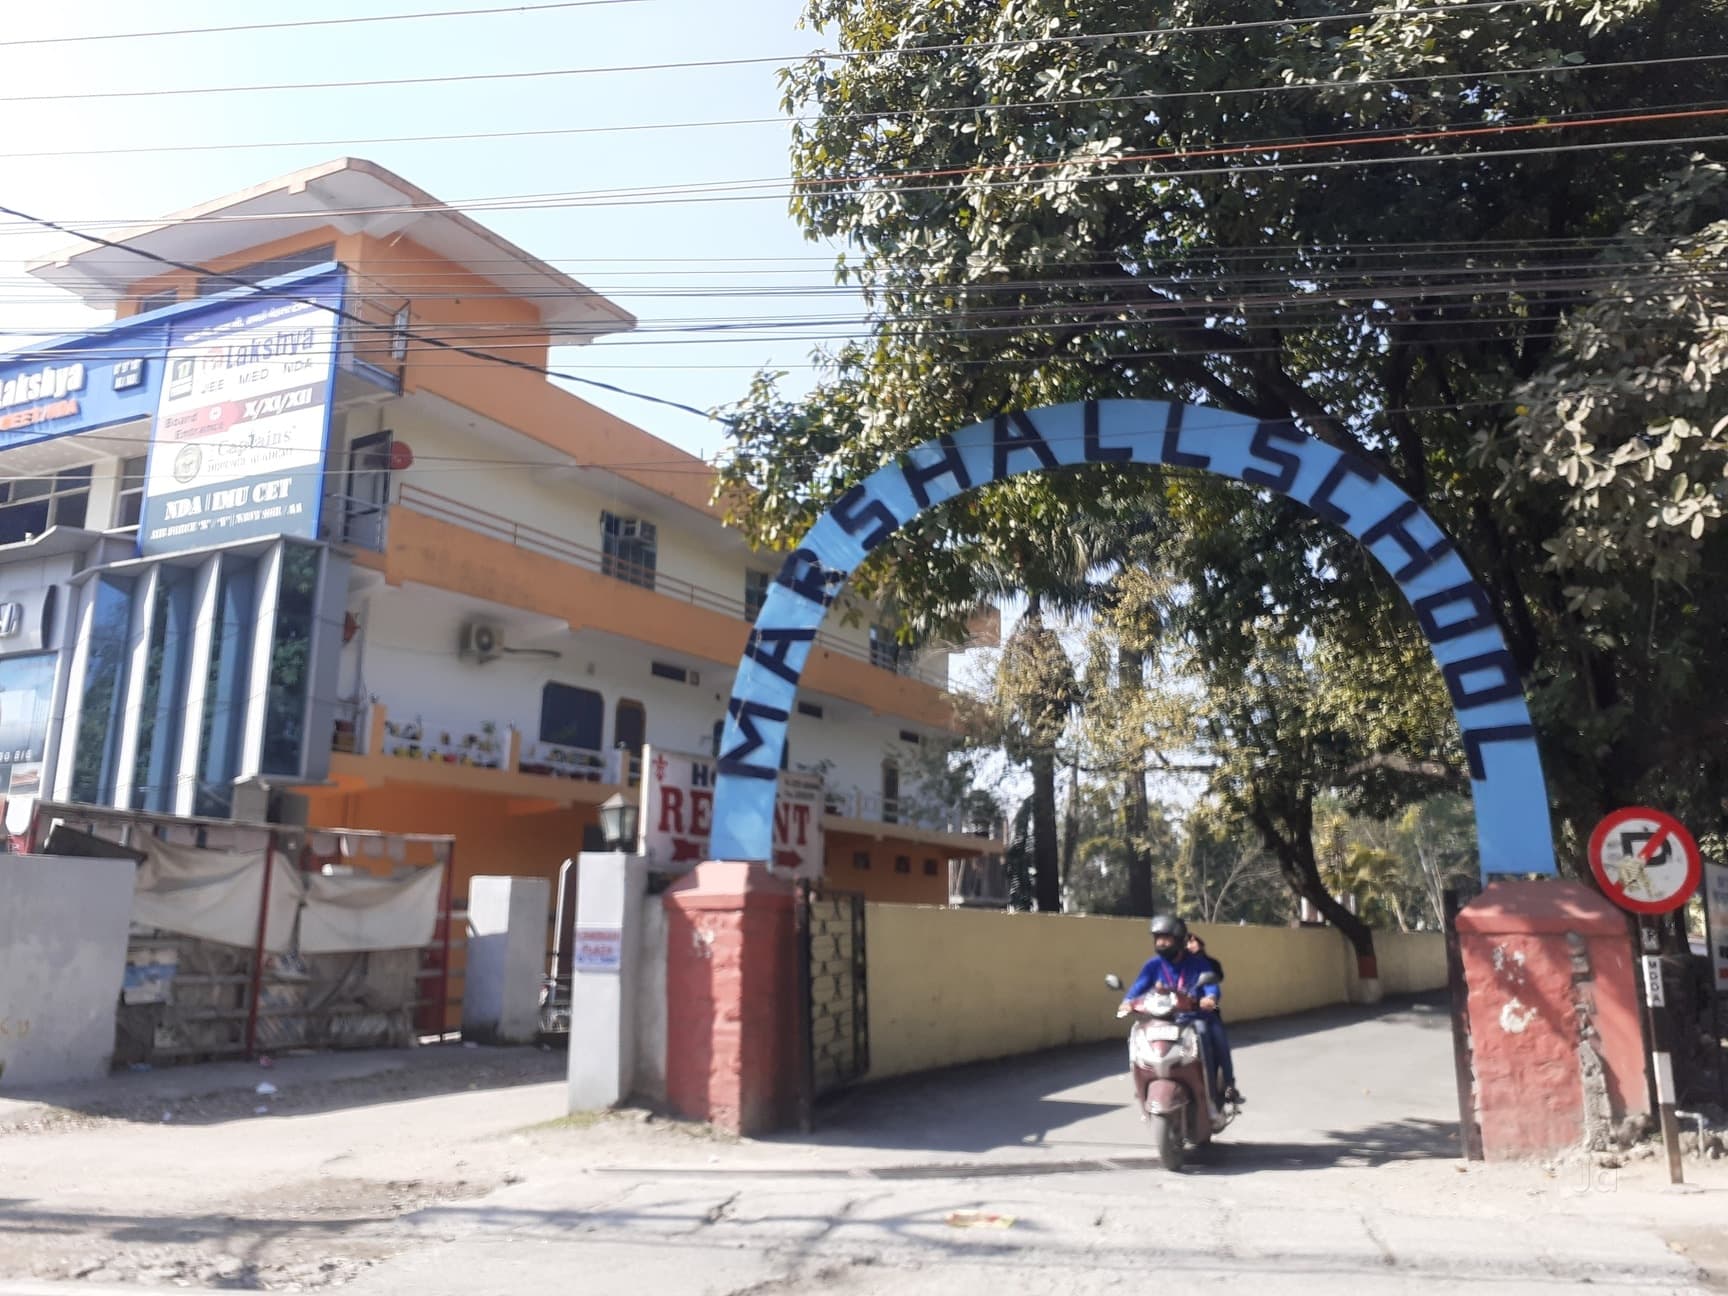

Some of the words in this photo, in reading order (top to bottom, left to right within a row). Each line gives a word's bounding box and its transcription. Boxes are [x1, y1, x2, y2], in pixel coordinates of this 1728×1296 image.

[0, 363, 84, 411] akshya
[239, 368, 270, 385] MED
[164, 496, 202, 520] NDA
[717, 401, 1212, 780] MARSHALL
[1242, 414, 1535, 782] SCHOOL
